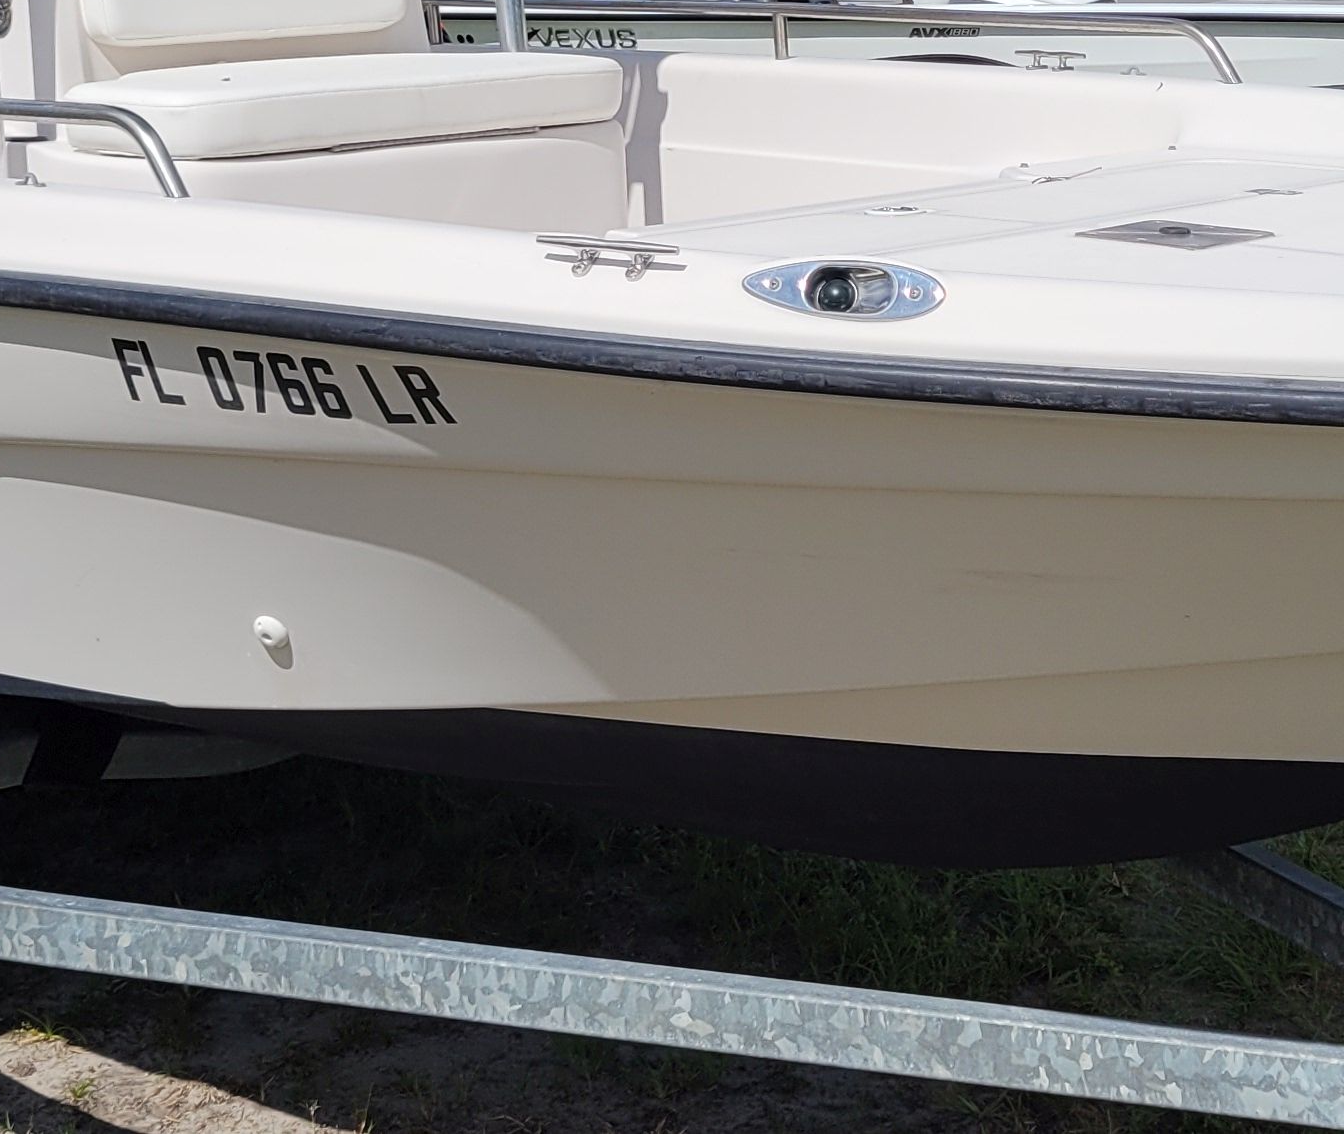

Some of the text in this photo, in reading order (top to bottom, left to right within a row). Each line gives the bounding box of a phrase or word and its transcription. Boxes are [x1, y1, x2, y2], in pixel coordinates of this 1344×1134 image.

[534, 26, 638, 49] VEXUS
[111, 337, 458, 425] FL 0766 LR
